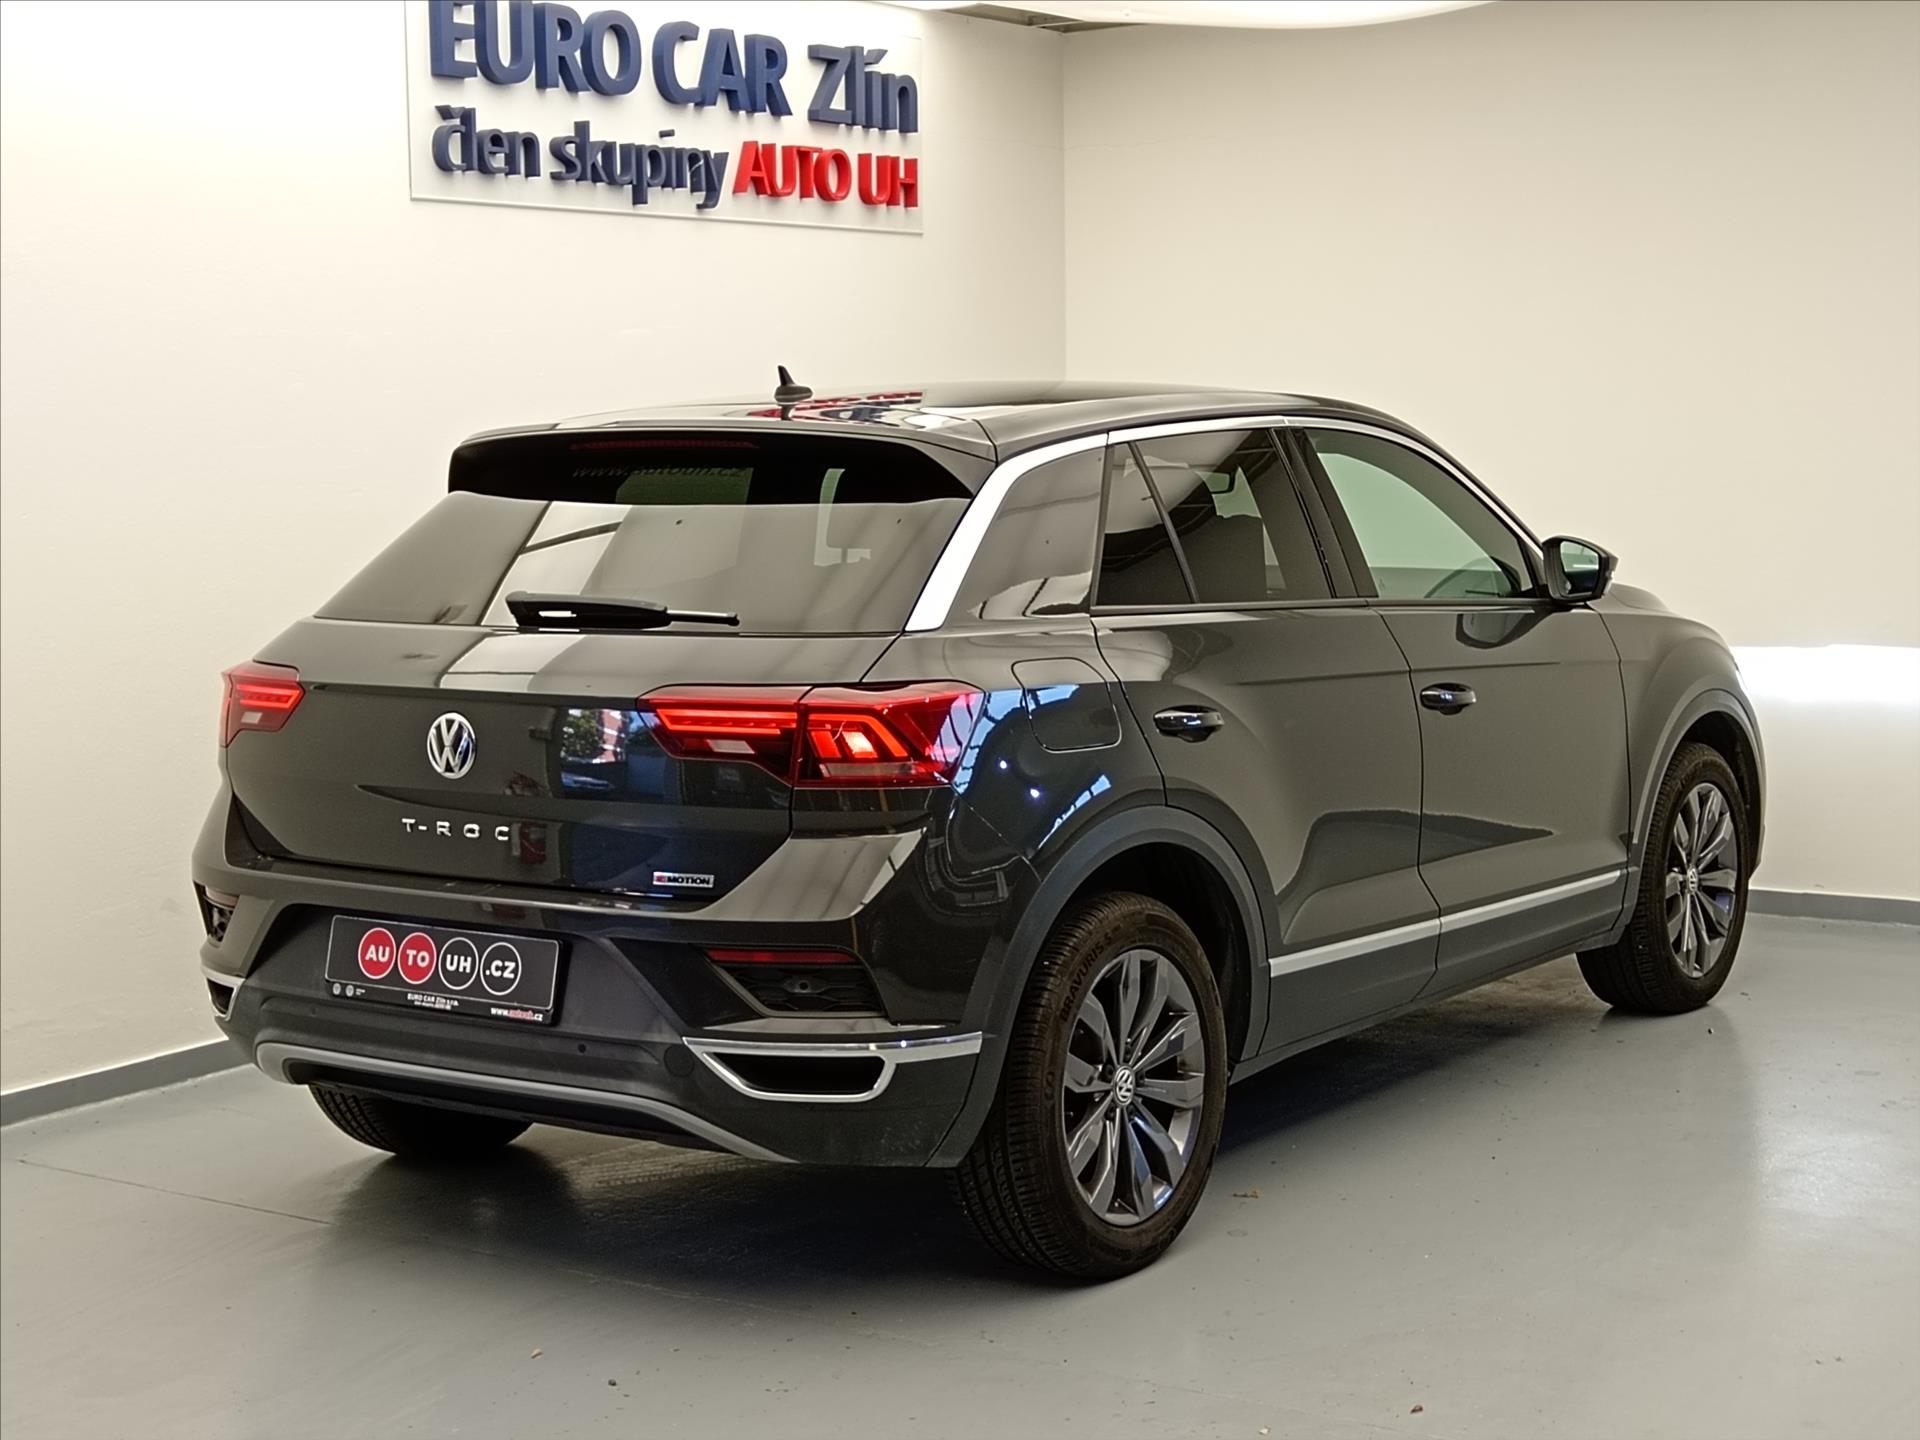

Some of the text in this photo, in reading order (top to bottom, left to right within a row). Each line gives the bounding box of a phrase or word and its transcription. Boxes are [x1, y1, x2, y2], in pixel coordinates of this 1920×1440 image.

[429, 0, 919, 133] EURO CAR Zlín
[432, 104, 542, 178] člen
[732, 140, 852, 200] AUTO
[857, 152, 919, 208] UH
[365, 944, 390, 963] AU
[406, 949, 430, 968] TO
[445, 954, 472, 973] UH
